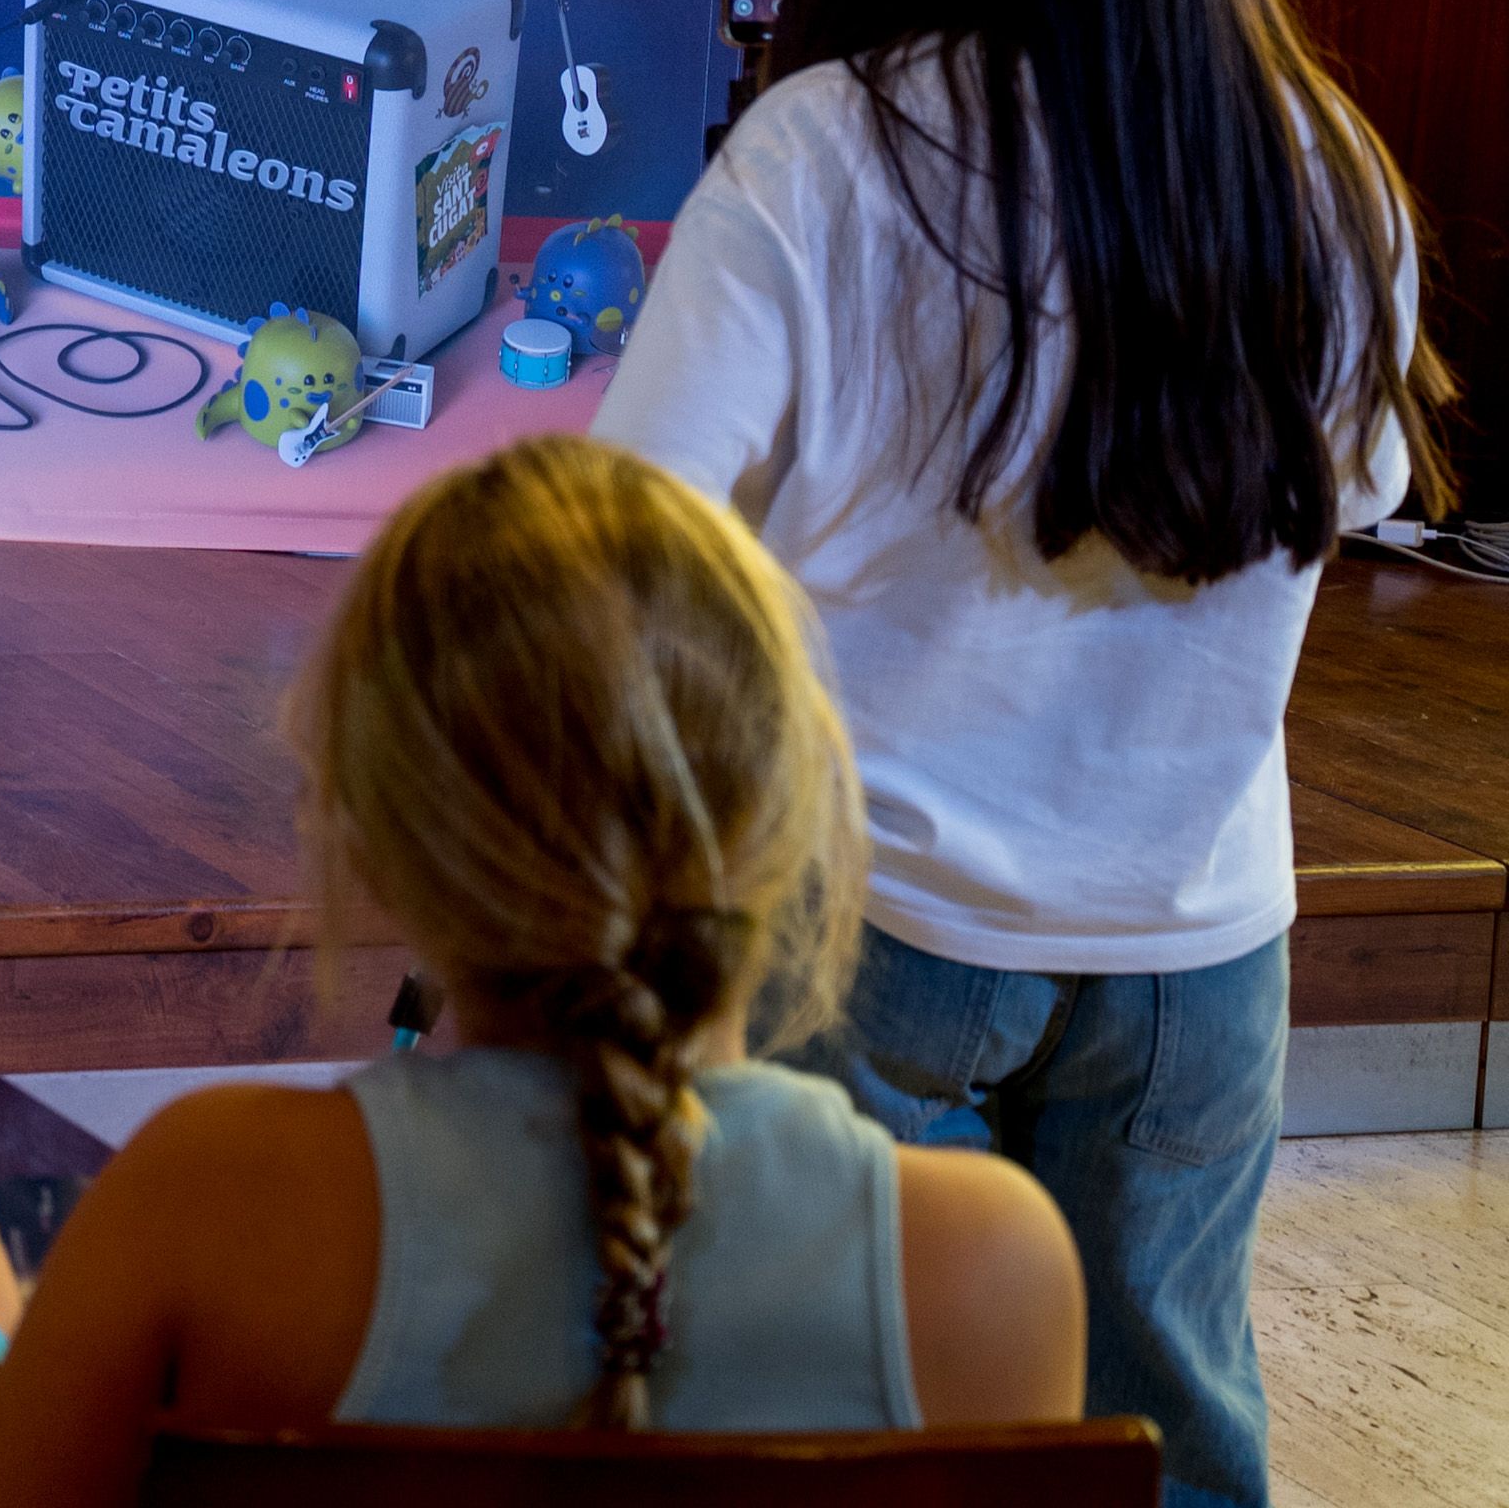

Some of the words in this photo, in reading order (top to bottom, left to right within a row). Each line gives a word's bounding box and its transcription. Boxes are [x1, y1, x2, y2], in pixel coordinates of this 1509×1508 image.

[283, 78, 296, 87] AUX
[308, 86, 326, 96] HEAD
[433, 170, 472, 222] SANT
[437, 162, 470, 196] Visita
[429, 186, 477, 249] CUGAT
